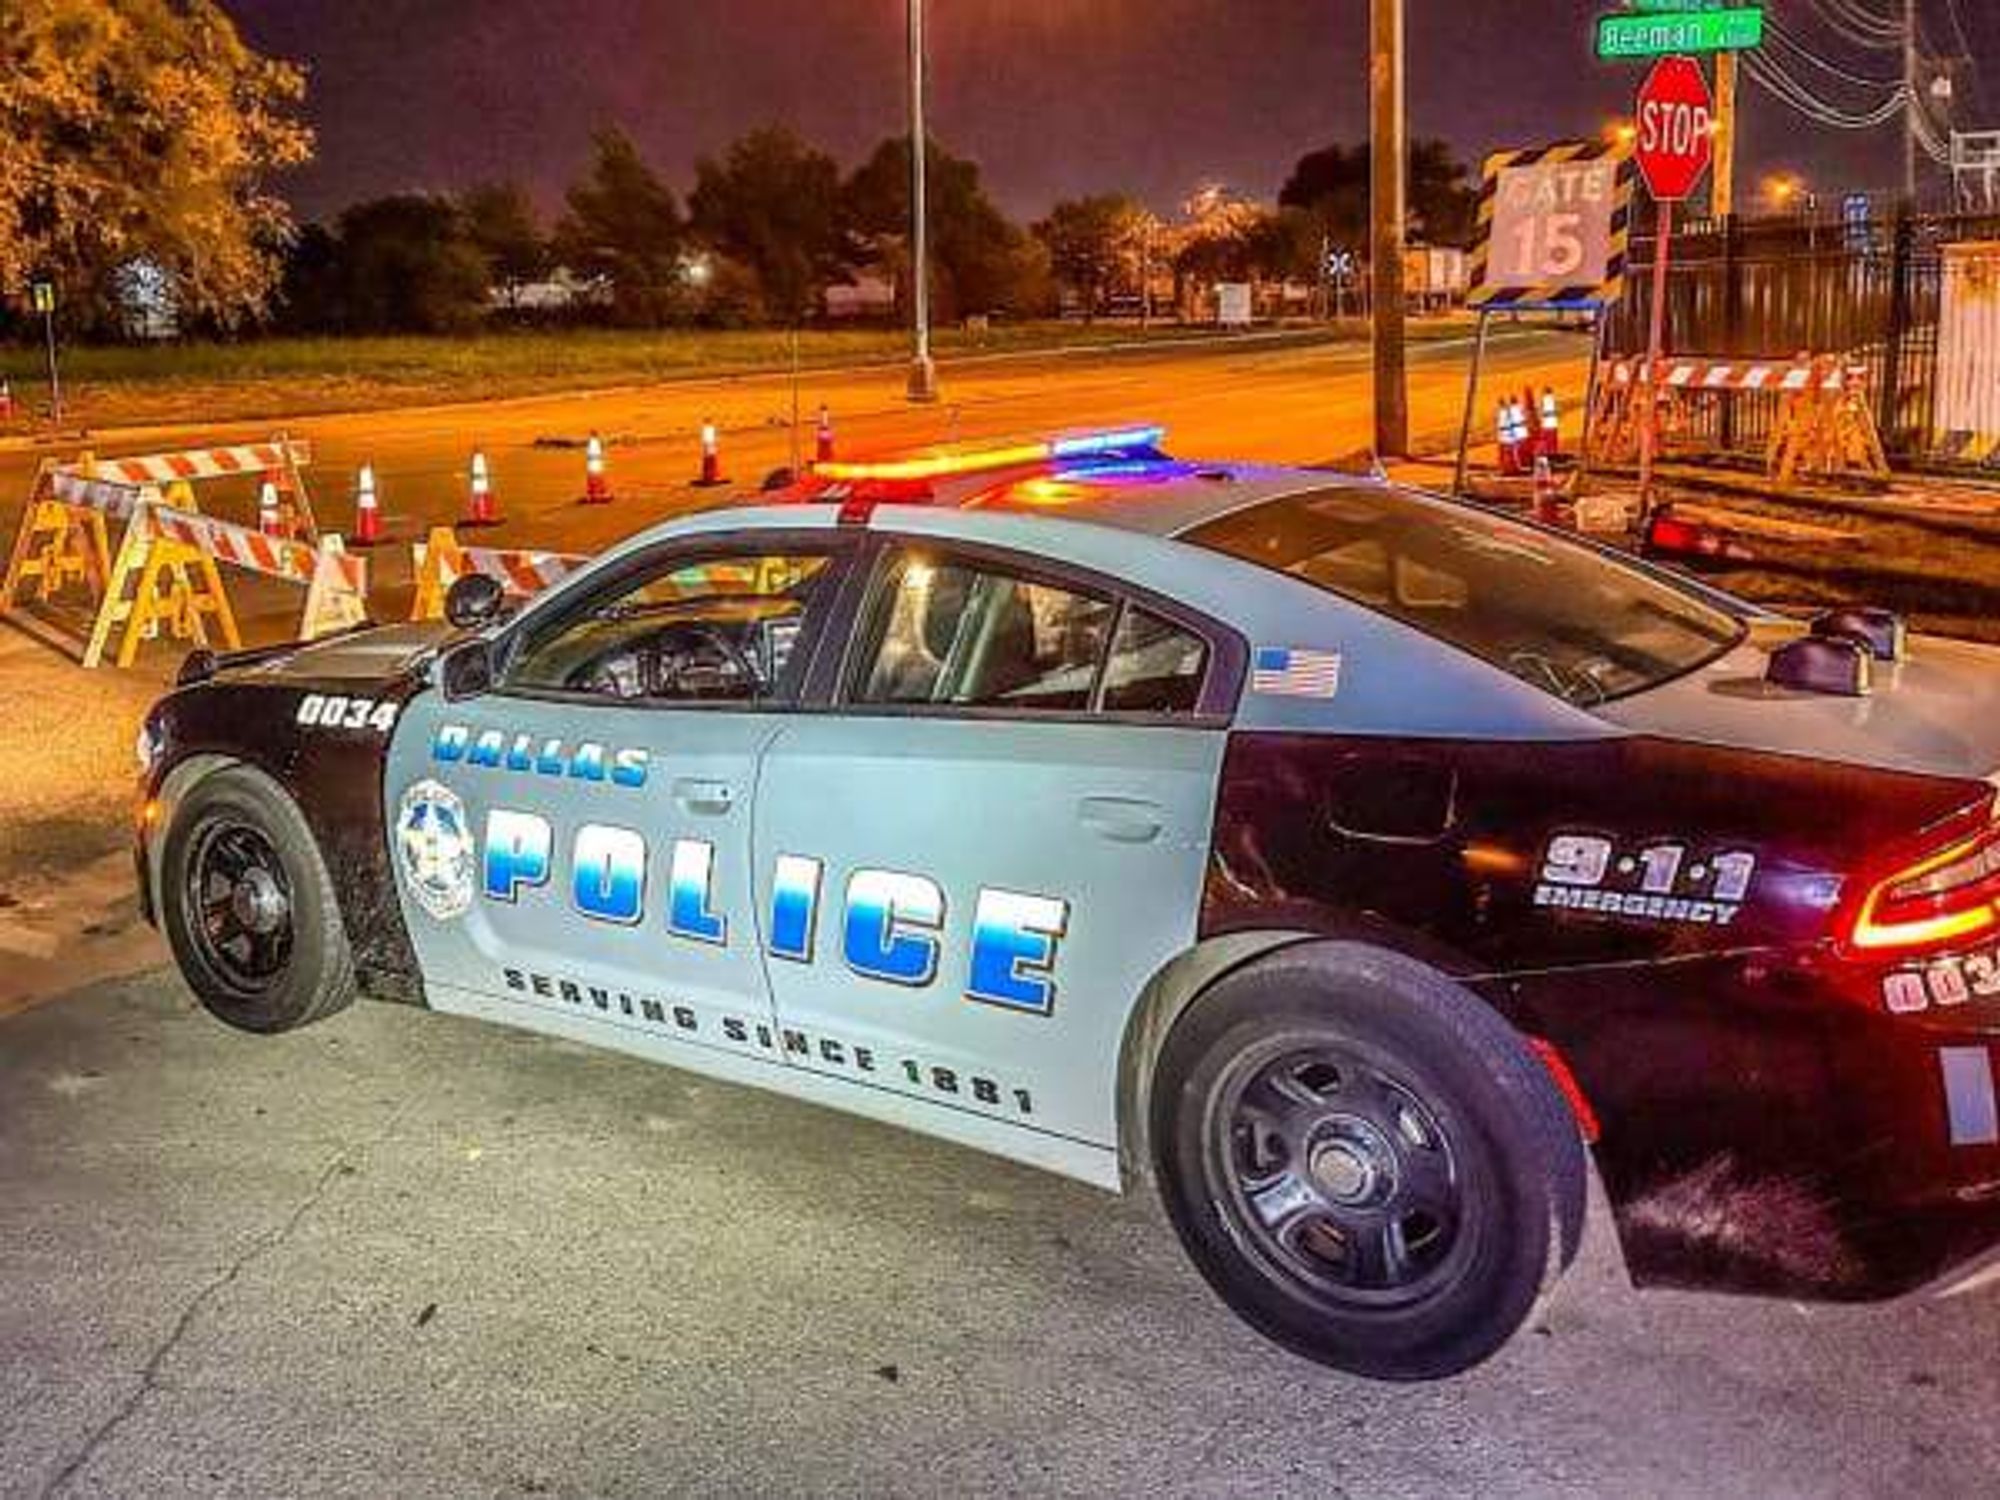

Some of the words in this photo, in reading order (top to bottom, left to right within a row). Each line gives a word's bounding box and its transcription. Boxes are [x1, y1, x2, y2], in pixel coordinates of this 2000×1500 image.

[1642, 102, 1708, 156] STOP
[1506, 166, 1602, 211] GATE
[1511, 213, 1583, 275] 15
[297, 694, 398, 731] 0034
[432, 725, 649, 788] DALLAS
[483, 808, 1069, 1017] POLICE
[1533, 885, 1739, 924] EMERGENCY
[1883, 949, 2000, 1014] 003
[503, 968, 698, 1030] SERVING
[722, 1017, 876, 1071] SINCE
[900, 1059, 1033, 1115] 1881
